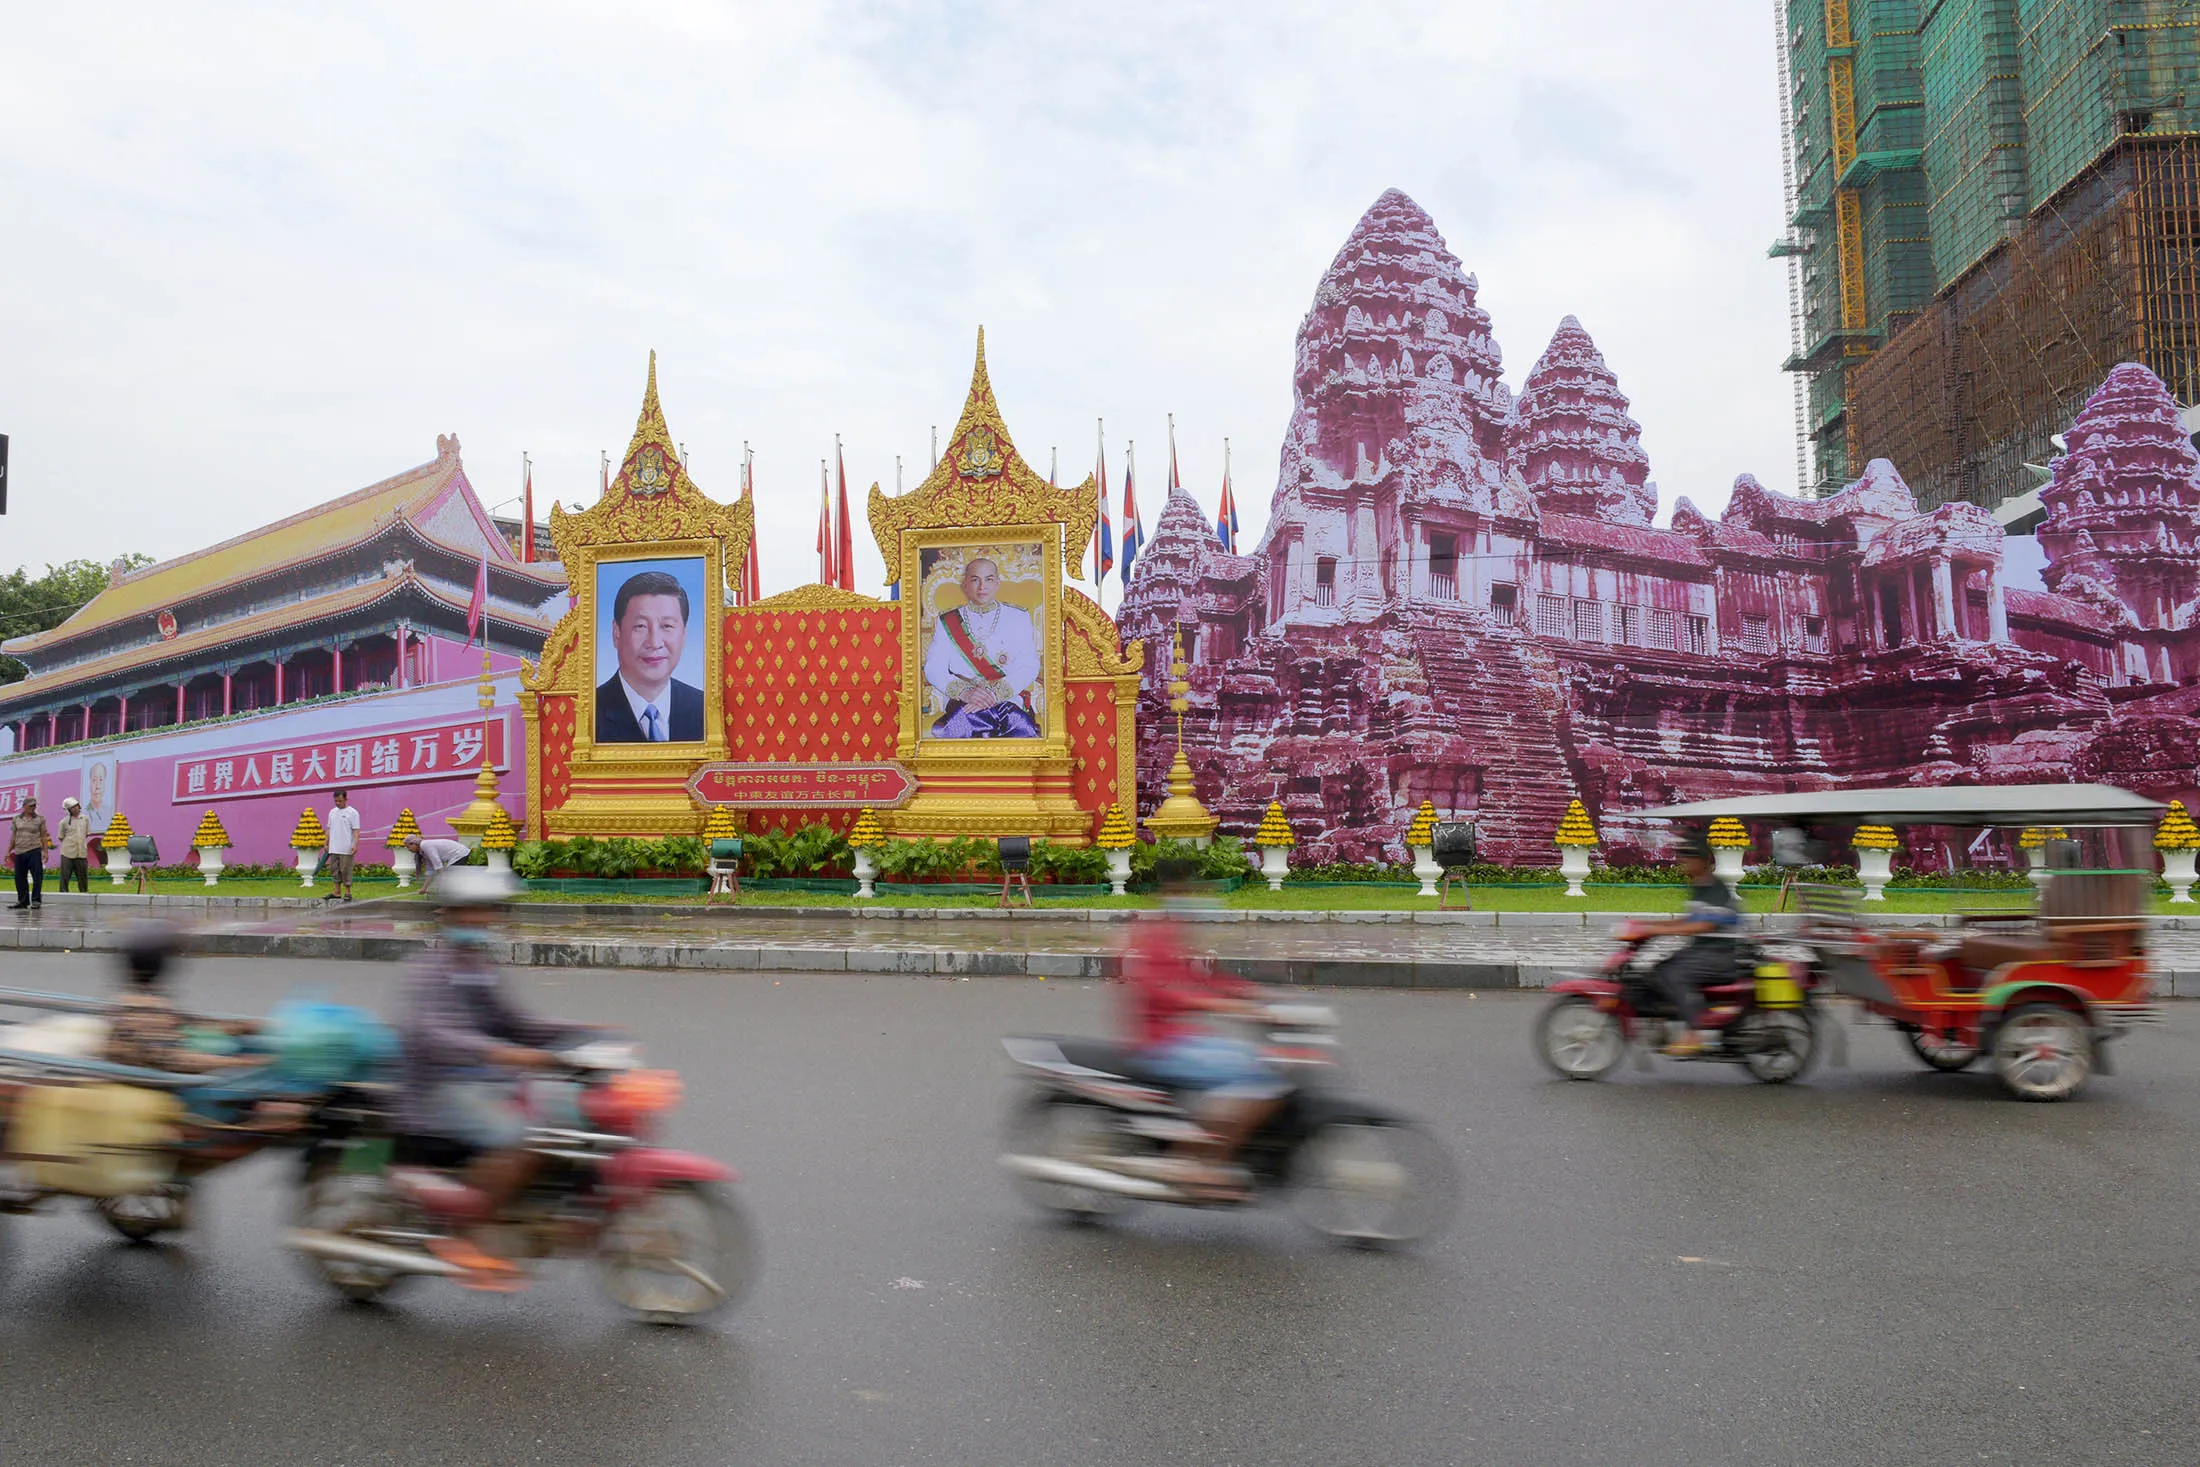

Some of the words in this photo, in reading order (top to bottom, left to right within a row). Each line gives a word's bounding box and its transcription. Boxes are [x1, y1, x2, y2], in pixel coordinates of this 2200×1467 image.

[187, 727, 483, 794] 世界人民大团结万岁
